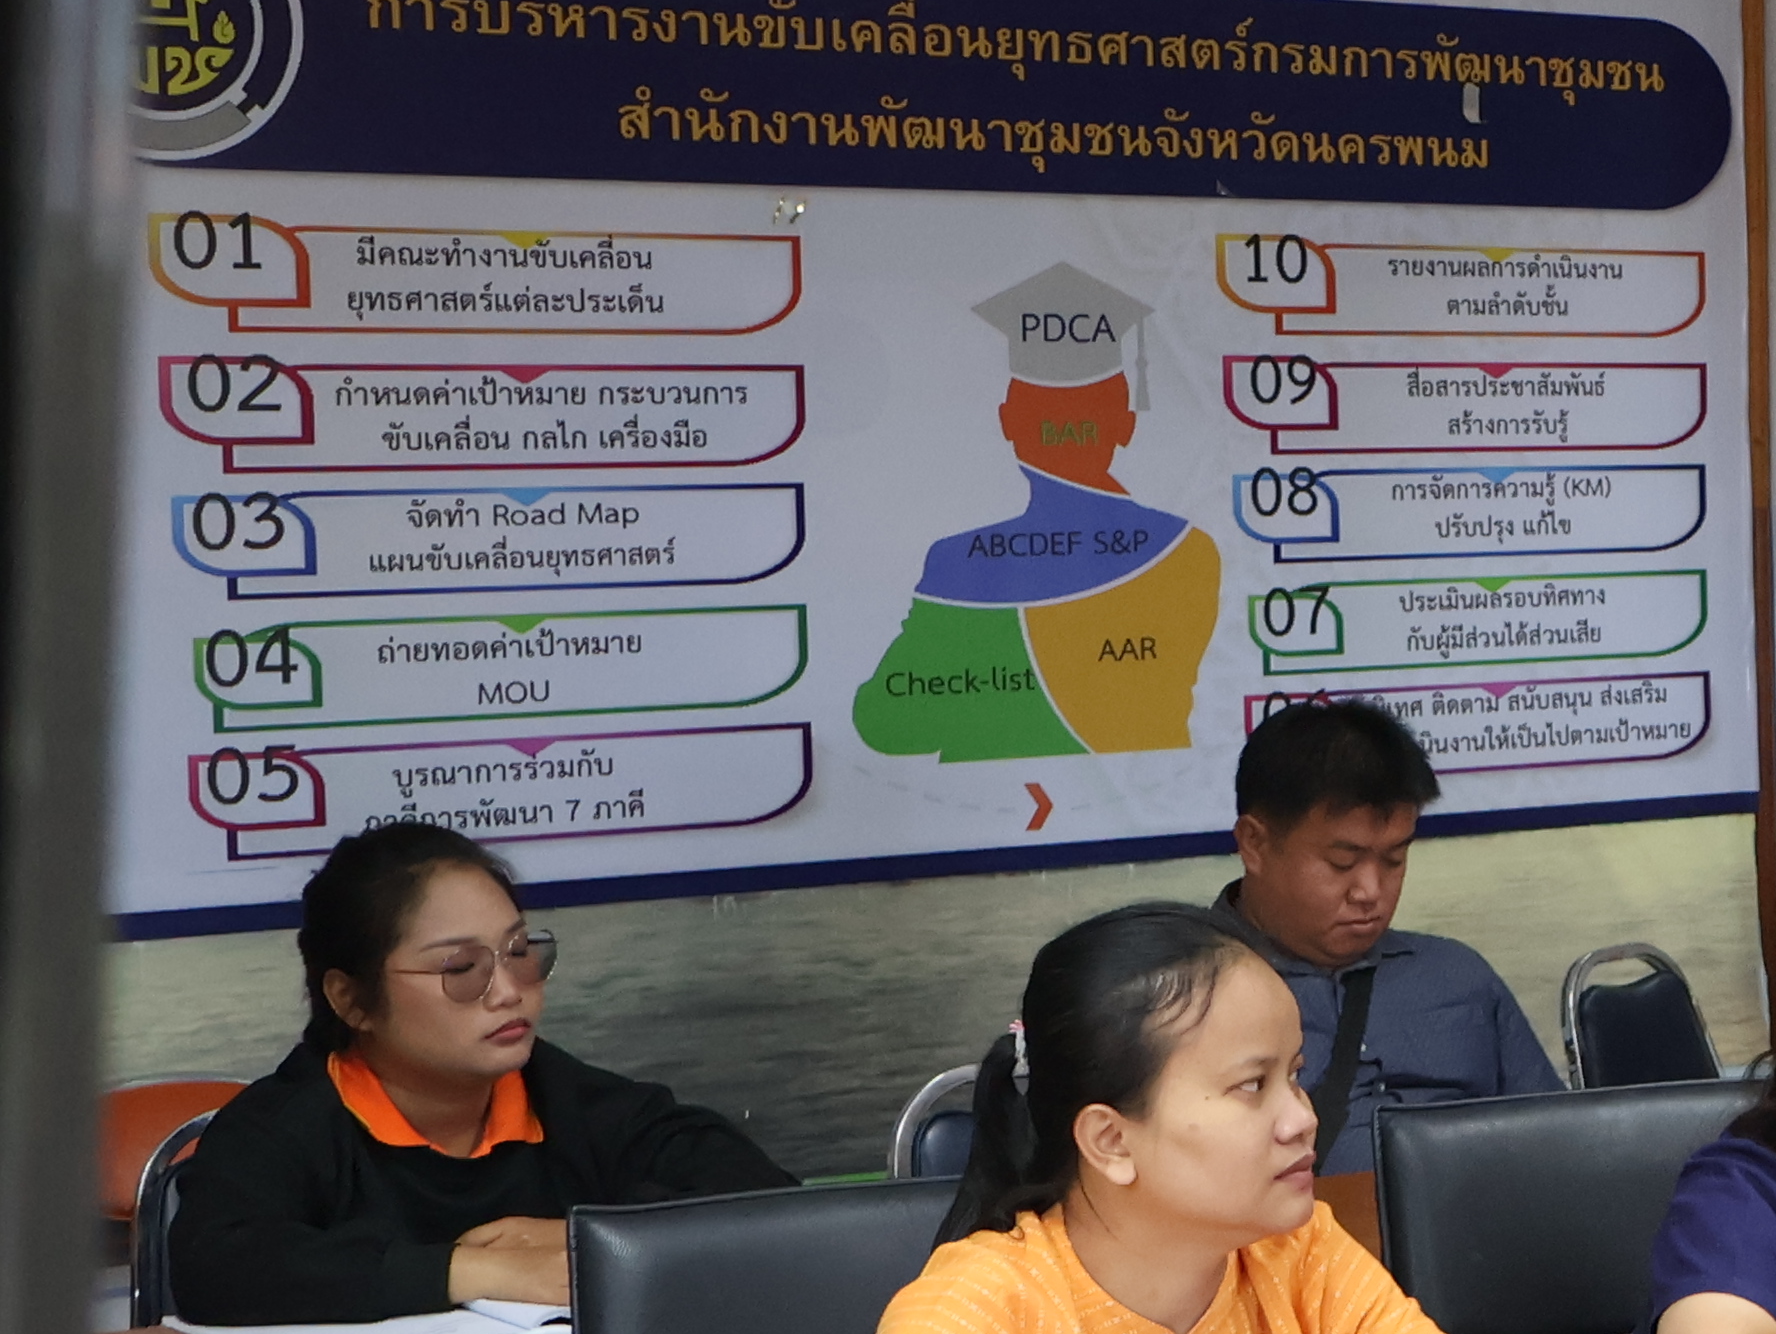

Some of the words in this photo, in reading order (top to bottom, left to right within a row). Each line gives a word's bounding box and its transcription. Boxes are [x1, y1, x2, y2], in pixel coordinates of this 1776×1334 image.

[617, 86, 1491, 174] สำนักงานพัฒนาชุมชนจังหวัดนครพนม
[173, 210, 264, 270] 01
[356, 235, 654, 271] มีคณะทำงานขับเคลื่อน
[1245, 234, 1309, 284] 10
[1387, 251, 1624, 281] รายงานผลการดำเนินงาน
[347, 284, 665, 319] ยุทธศาสตร์แต่ละประเด็น
[1446, 287, 1570, 320] ตามลำดับชั้น
[1020, 313, 1116, 344] PDCA
[186, 353, 284, 413] 02
[334, 375, 587, 408] กำหนดค่าเป้าหมาย
[598, 381, 749, 408] กระบวนการ
[1250, 354, 1318, 406] 09
[1406, 368, 1606, 402] สื่อสารประชาสัมพันธ์
[382, 417, 511, 452] ขับเคลื่อน
[522, 417, 587, 451] กลไก
[599, 417, 708, 452] เครื่องมือ
[1040, 421, 1099, 448] BAR
[1446, 410, 1570, 444] สร้างการรับรู้
[1250, 467, 1318, 518] 08
[1391, 473, 1556, 506] การจัดการความรู้
[1561, 475, 1613, 501] (KM)
[192, 492, 286, 552] 03
[406, 498, 482, 530] จัดทำ
[492, 503, 567, 528] Road
[577, 503, 640, 530] Map
[1434, 508, 1513, 543] ปรับปรุง
[1523, 507, 1572, 539] แก้ไข
[368, 536, 676, 579] แผนขับเคลื่อนยุทธศาสตร์
[967, 530, 1083, 560] ABCDEF
[1094, 528, 1149, 555] S&P
[1264, 586, 1331, 638] 07
[1398, 583, 1606, 617] ประเมินผลรอบทิศทาง
[377, 626, 643, 665] ถ่ายทอดค่าเป้าหมาย
[1098, 636, 1158, 663] AAR
[1406, 618, 1602, 659] กับผู้มีส่วนได้ส่วนเสีย
[205, 626, 300, 688] 04
[477, 680, 551, 706] MOU
[884, 667, 1036, 699] Check-list
[1432, 692, 1500, 717] ติดตาม
[1507, 687, 1592, 716] สนับสนุน
[1600, 680, 1668, 708] ส่งเสริม
[207, 745, 301, 805] 05
[392, 747, 614, 799] บูรณาการร่วมกับ
[565, 798, 581, 822] 7
[593, 787, 645, 821] ภาคี
